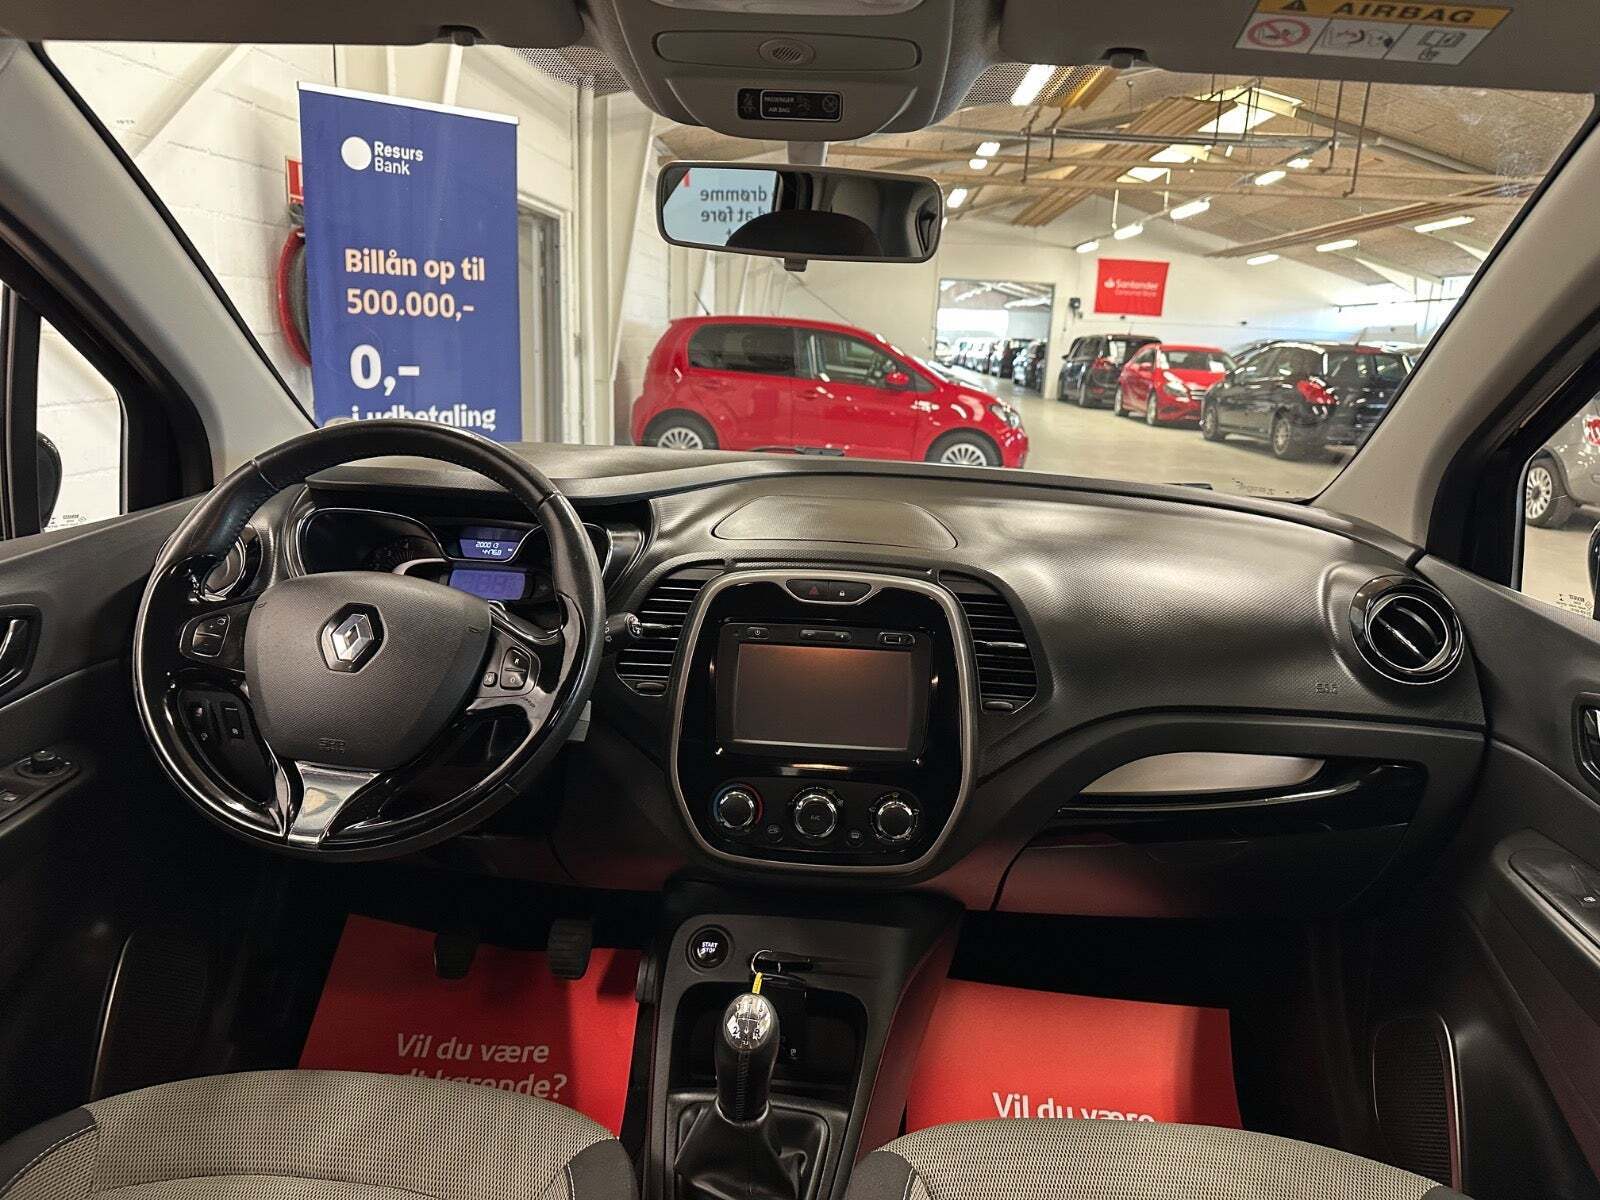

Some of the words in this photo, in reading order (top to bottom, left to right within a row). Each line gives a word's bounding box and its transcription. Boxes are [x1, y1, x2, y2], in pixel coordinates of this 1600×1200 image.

[1332, 1, 1476, 24] AIRBAG
[374, 141, 424, 161] Resurs
[374, 156, 411, 176] Bank
[344, 247, 418, 277] Billån
[423, 259, 456, 285] op
[461, 256, 486, 282] til
[346, 287, 475, 322] 500.000,-
[350, 343, 421, 397] 0,-
[702, 941, 719, 949] START
[397, 1033, 433, 1059] Vil
[436, 1036, 473, 1061] du
[480, 1043, 550, 1064] være
[992, 1091, 1030, 1119] Vil
[1037, 1097, 1074, 1119] du
